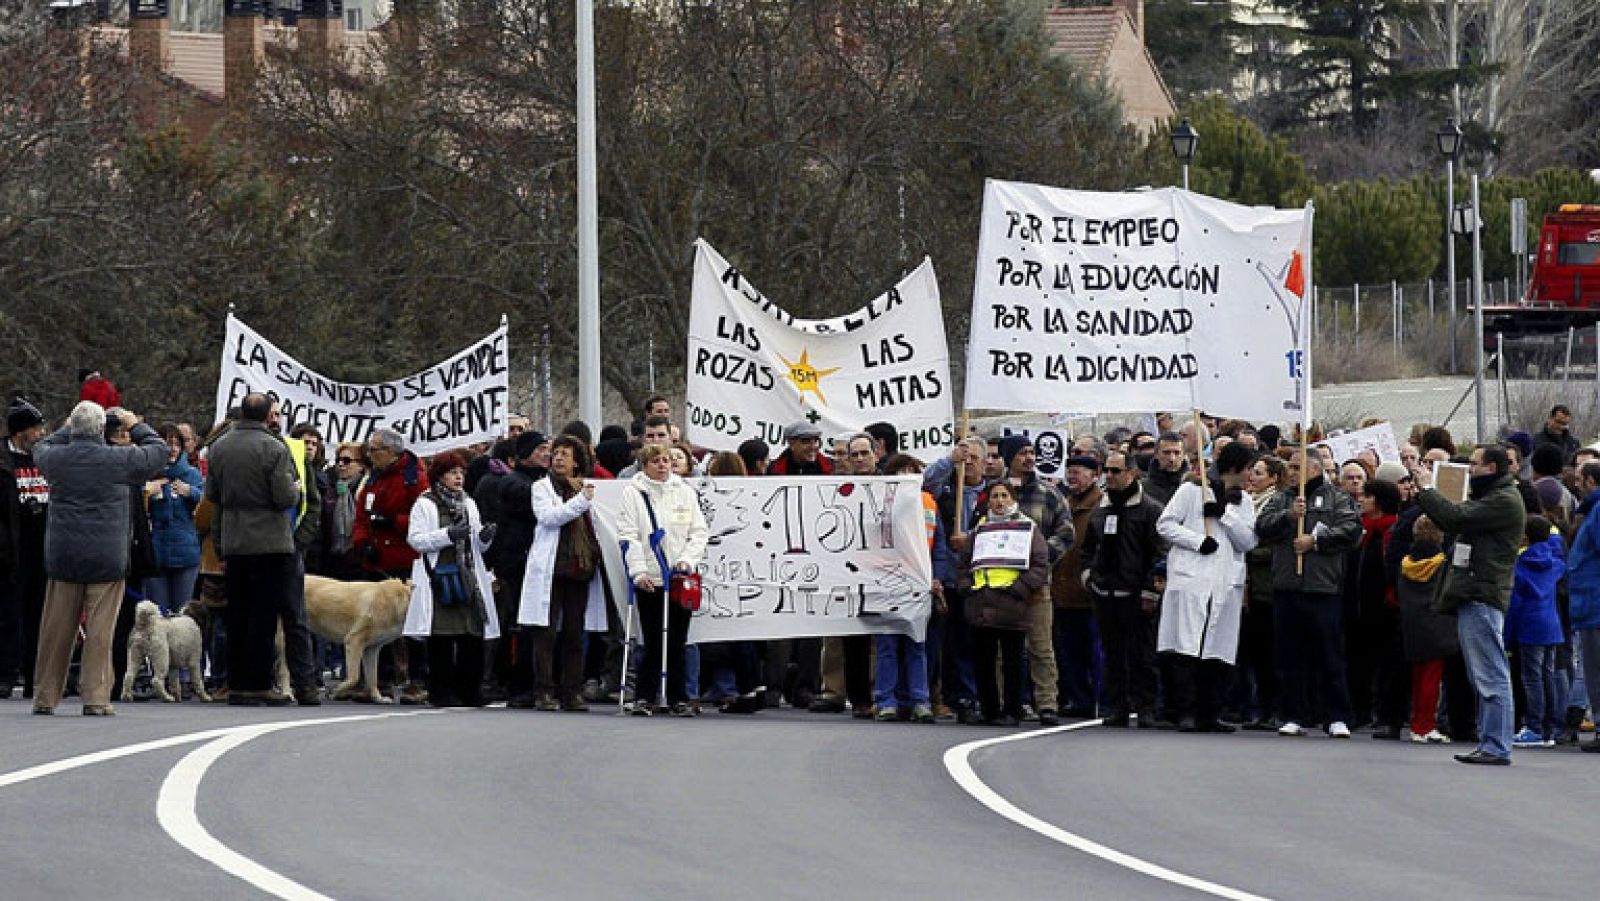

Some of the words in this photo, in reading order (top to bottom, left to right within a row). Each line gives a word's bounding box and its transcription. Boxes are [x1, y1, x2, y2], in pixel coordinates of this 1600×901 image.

[1081, 218, 1180, 247] EMPLEO
[1053, 262, 1075, 294] LA
[1079, 262, 1220, 294] EDUCACIÓN
[717, 316, 761, 351] LAS
[1044, 307, 1069, 335] LA
[1077, 307, 1194, 337] SANIDAD
[861, 334, 914, 368] LAS
[1045, 354, 1071, 382] LA
[1077, 353, 1199, 382] DIGNIDAD
[235, 333, 269, 374] LA
[275, 360, 397, 408] SANIDAD
[403, 371, 436, 401] SE
[437, 335, 507, 391] VENDE
[696, 348, 775, 391] ROZAS
[791, 368, 817, 383] 15M
[856, 371, 943, 409] MATAS
[228, 377, 251, 406] E
[410, 386, 507, 444] RESIENTE
[690, 583, 883, 618] OSPITAL
